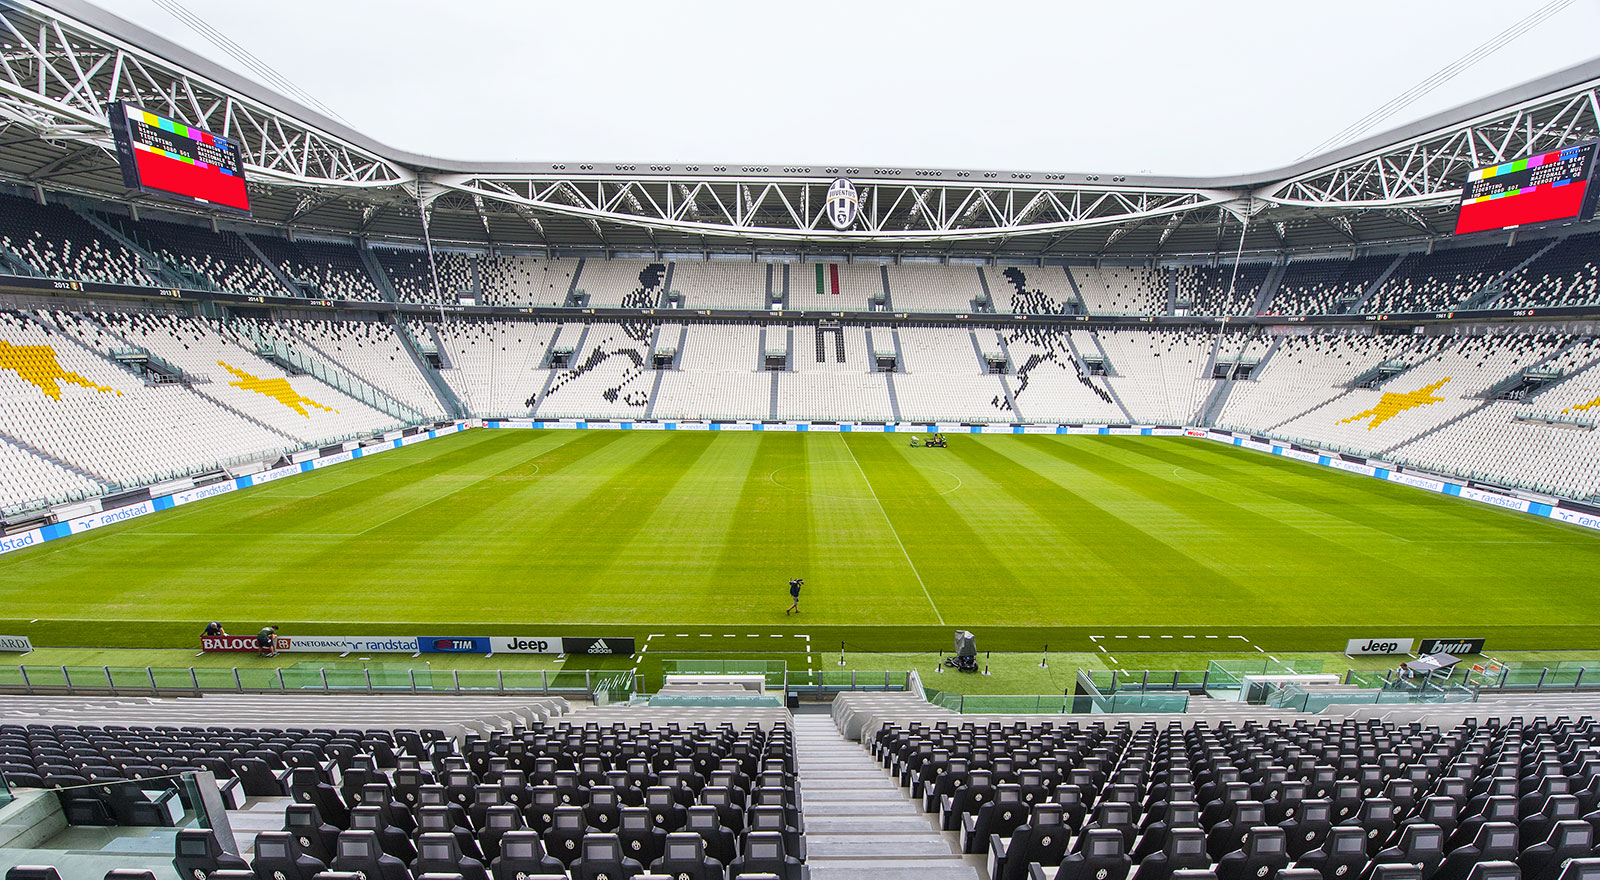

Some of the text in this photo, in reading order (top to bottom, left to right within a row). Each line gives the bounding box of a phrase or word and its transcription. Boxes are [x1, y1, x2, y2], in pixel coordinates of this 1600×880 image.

[829, 189, 856, 198] JUVENTUS
[270, 463, 298, 480] randstad
[1343, 461, 1371, 475] randstad
[1405, 476, 1439, 491] randstad
[196, 482, 233, 500] randstad
[1481, 493, 1522, 510] randstad
[101, 503, 148, 525] randstad
[0, 639, 30, 649] ARDI
[366, 638, 418, 651] randstad
[453, 640, 472, 649] TIM
[507, 637, 548, 652] Jeep
[1361, 640, 1398, 653] Jeep
[1430, 640, 1473, 654] bwin
